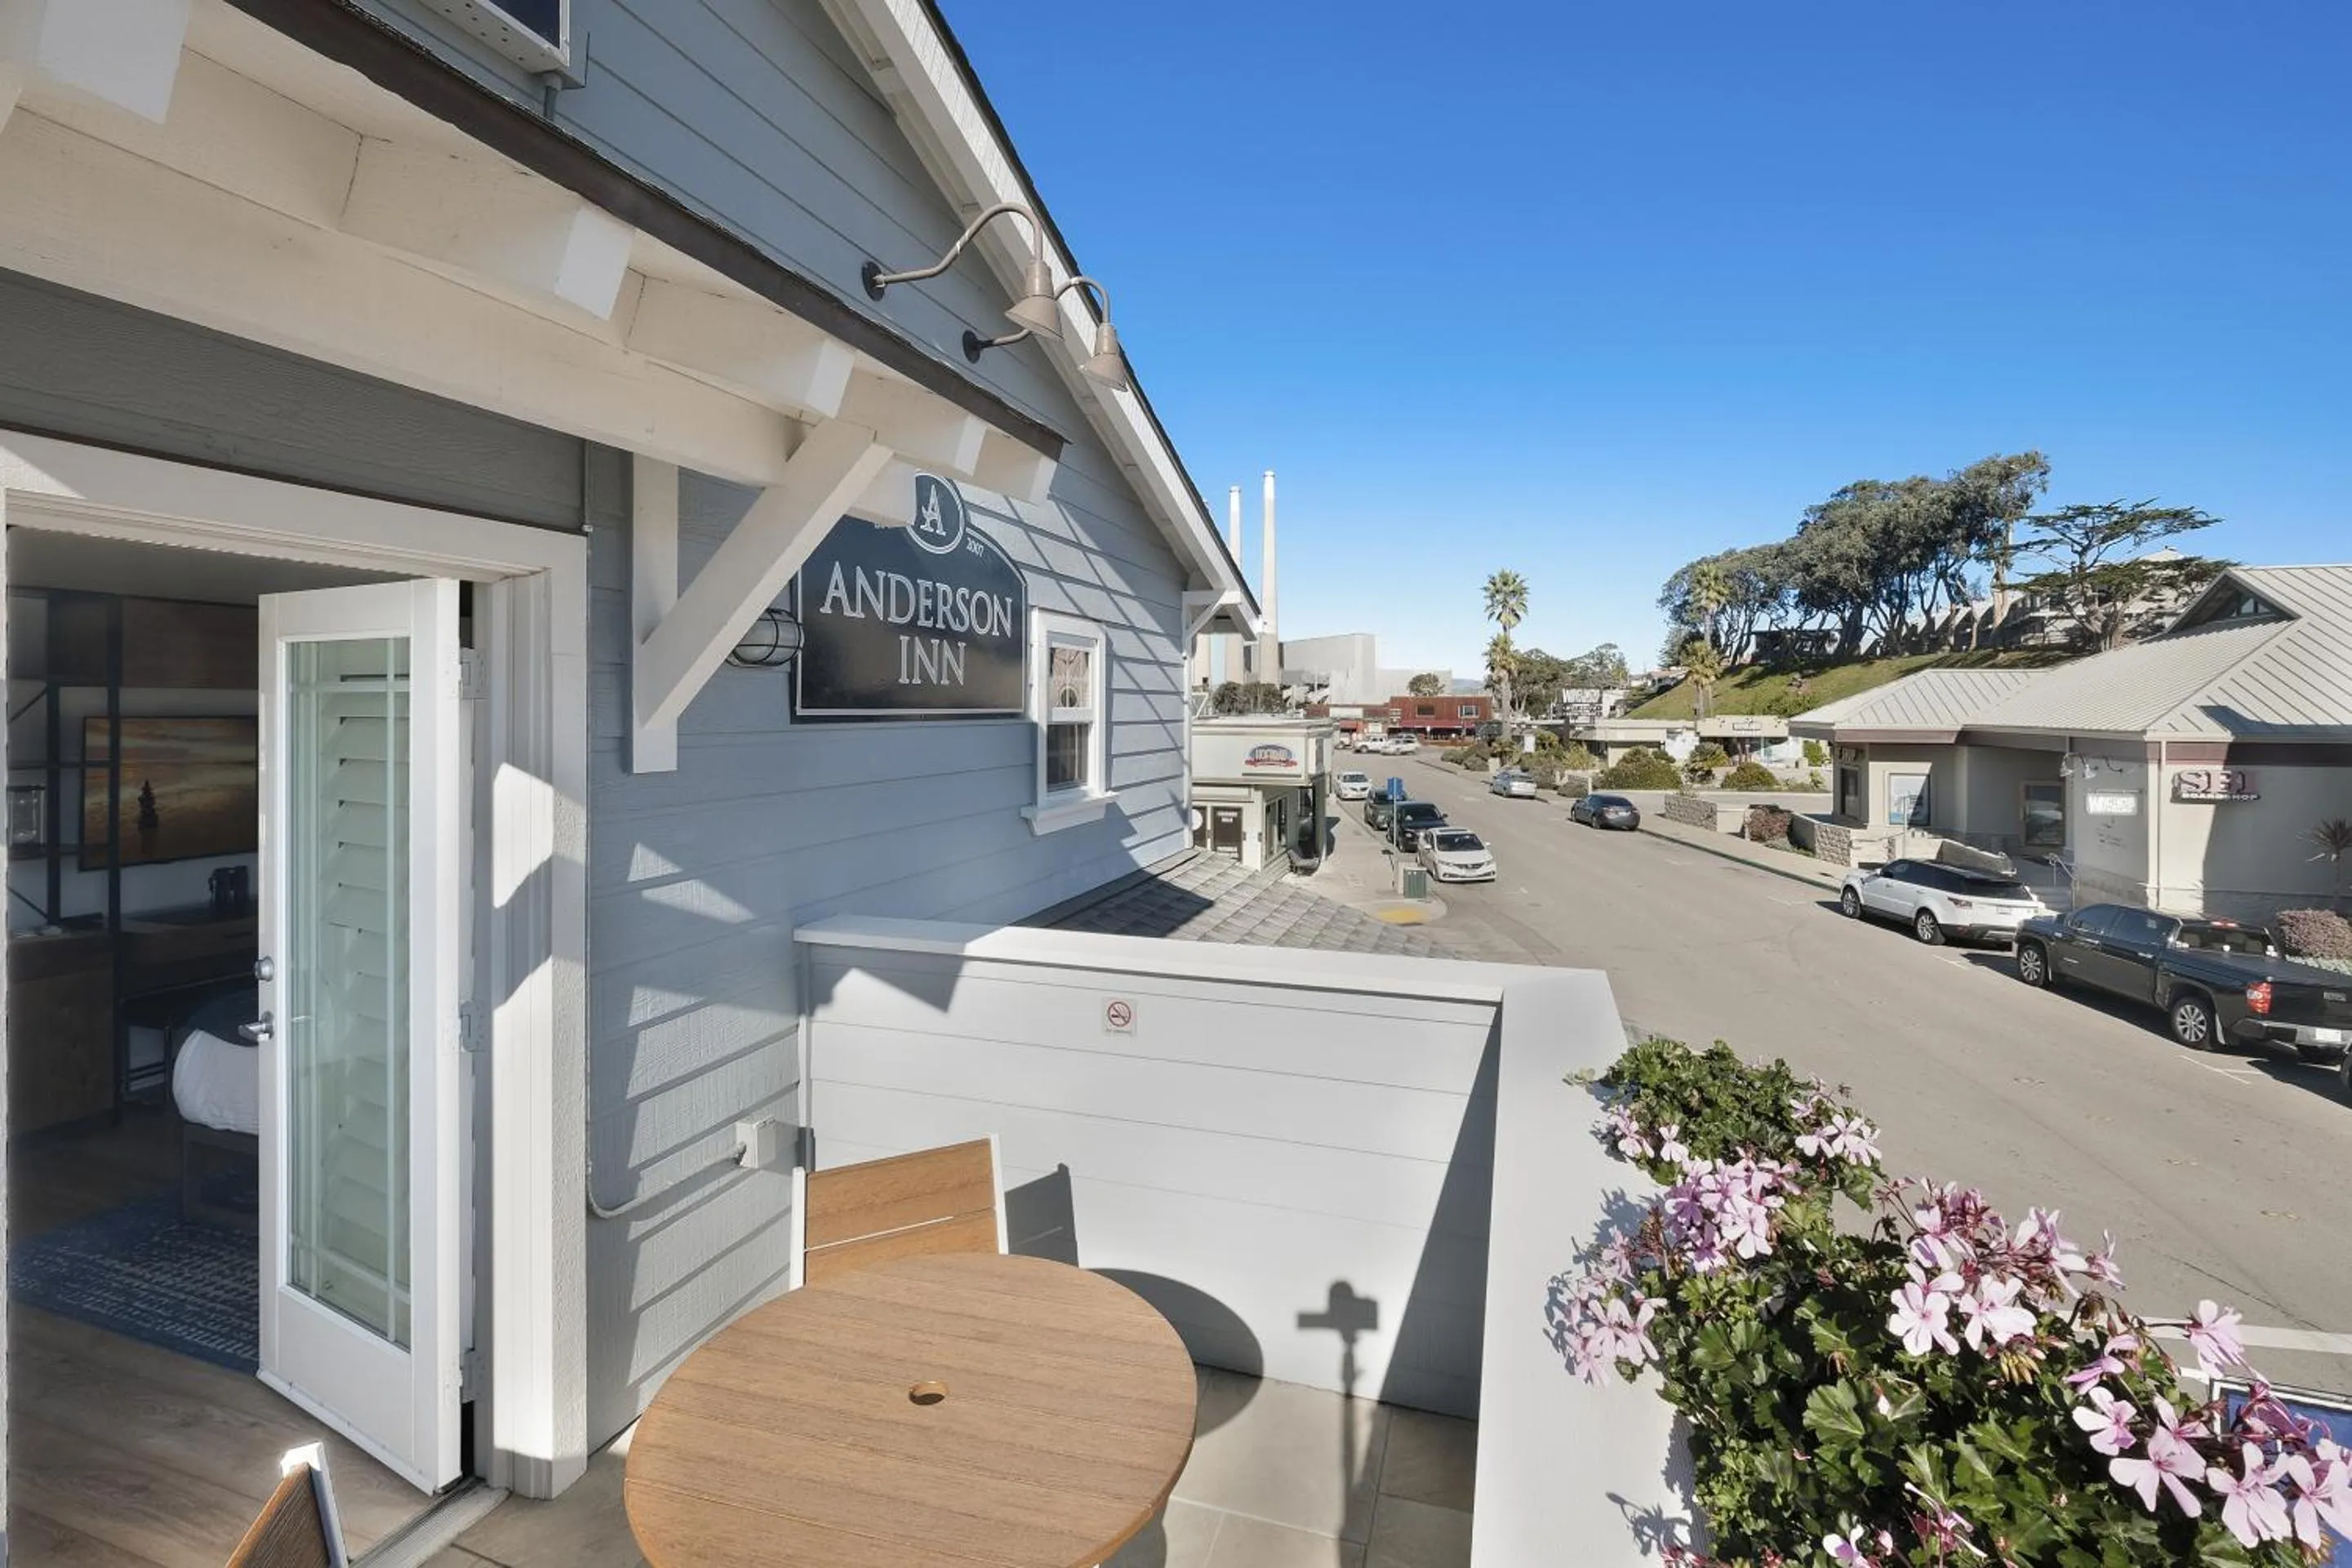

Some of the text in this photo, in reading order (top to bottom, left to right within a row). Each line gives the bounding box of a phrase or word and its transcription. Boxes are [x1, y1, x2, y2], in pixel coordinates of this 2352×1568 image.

[920, 484, 946, 536] A
[819, 561, 1012, 638] ANDERSON
[898, 634, 966, 686] INN
